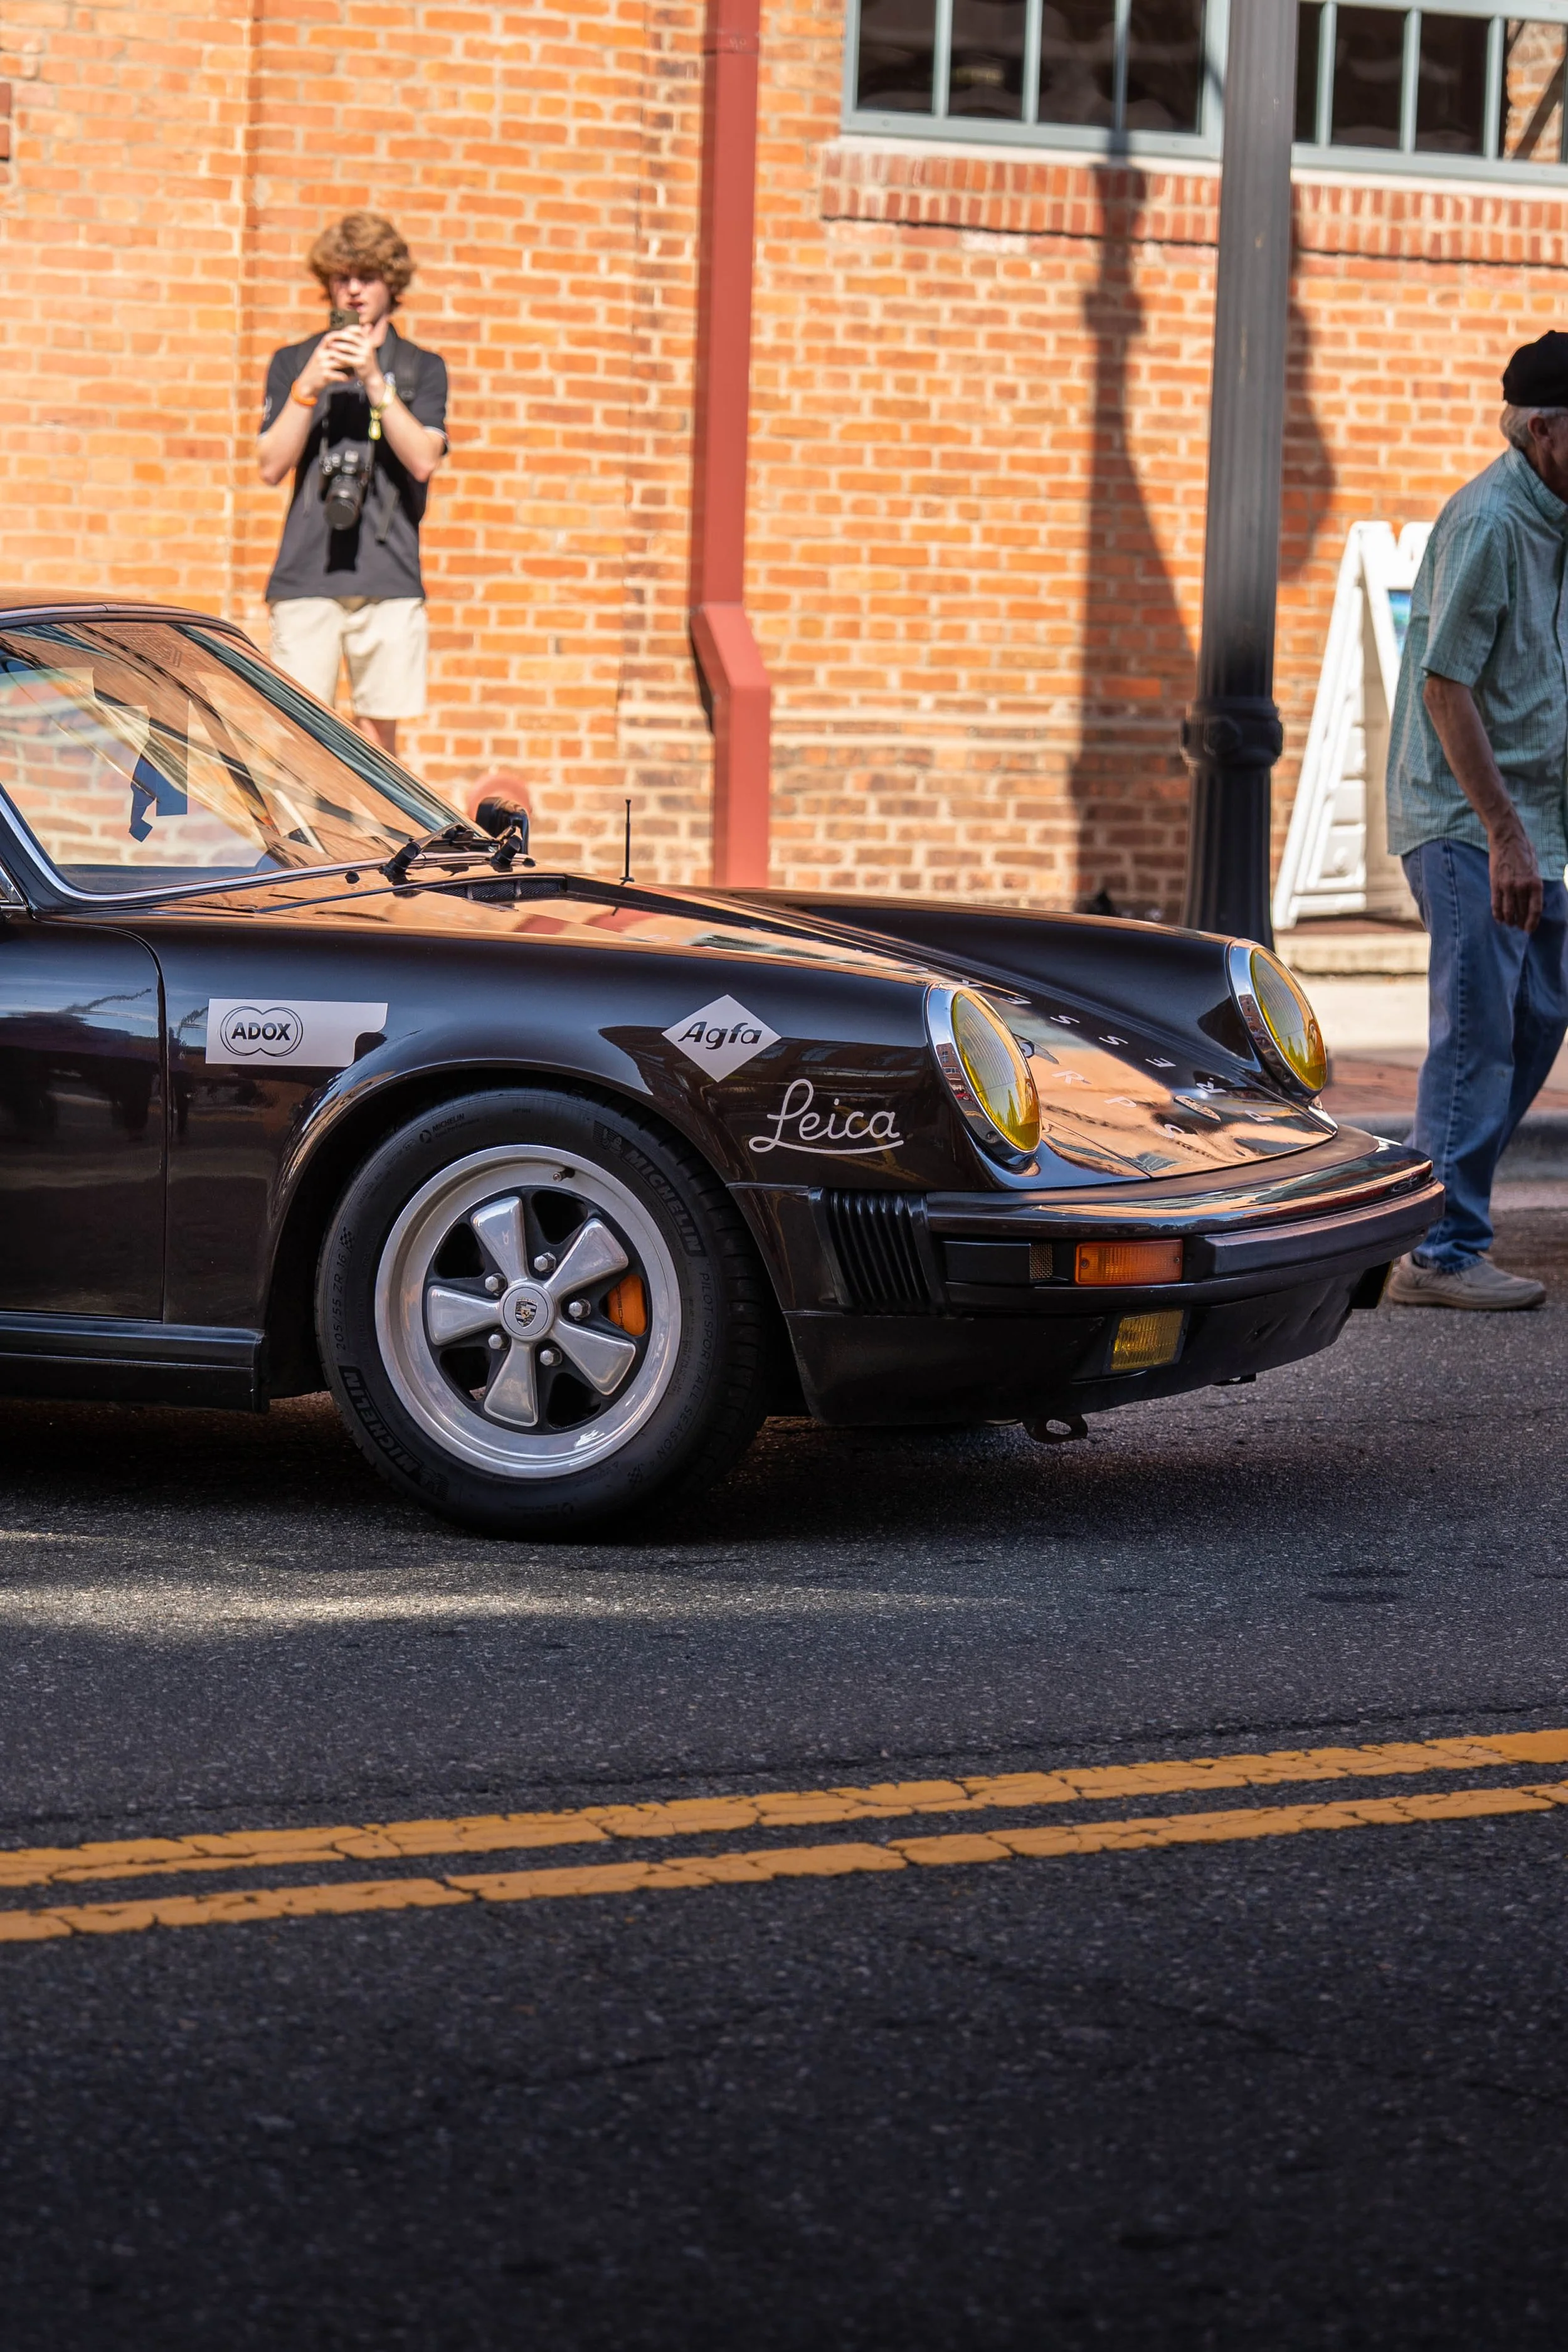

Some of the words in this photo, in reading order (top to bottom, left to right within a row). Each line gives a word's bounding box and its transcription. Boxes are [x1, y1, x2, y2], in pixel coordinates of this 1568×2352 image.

[231, 1022, 291, 1041] ADOX
[677, 1021, 763, 1050] Agfa
[432, 1113, 465, 1133] MICHELIN
[748, 1078, 904, 1155] Leica
[625, 1149, 702, 1251] MICHELIN
[337, 1253, 347, 1268] 16
[332, 1273, 344, 1295] ZR
[699, 1272, 714, 1315] PILOT
[332, 1298, 346, 1351] 205/55
[699, 1320, 714, 1371] SPORT
[689, 1372, 704, 1399] ALL
[344, 1372, 419, 1473] MICHELIN
[656, 1404, 692, 1460] SEASON
